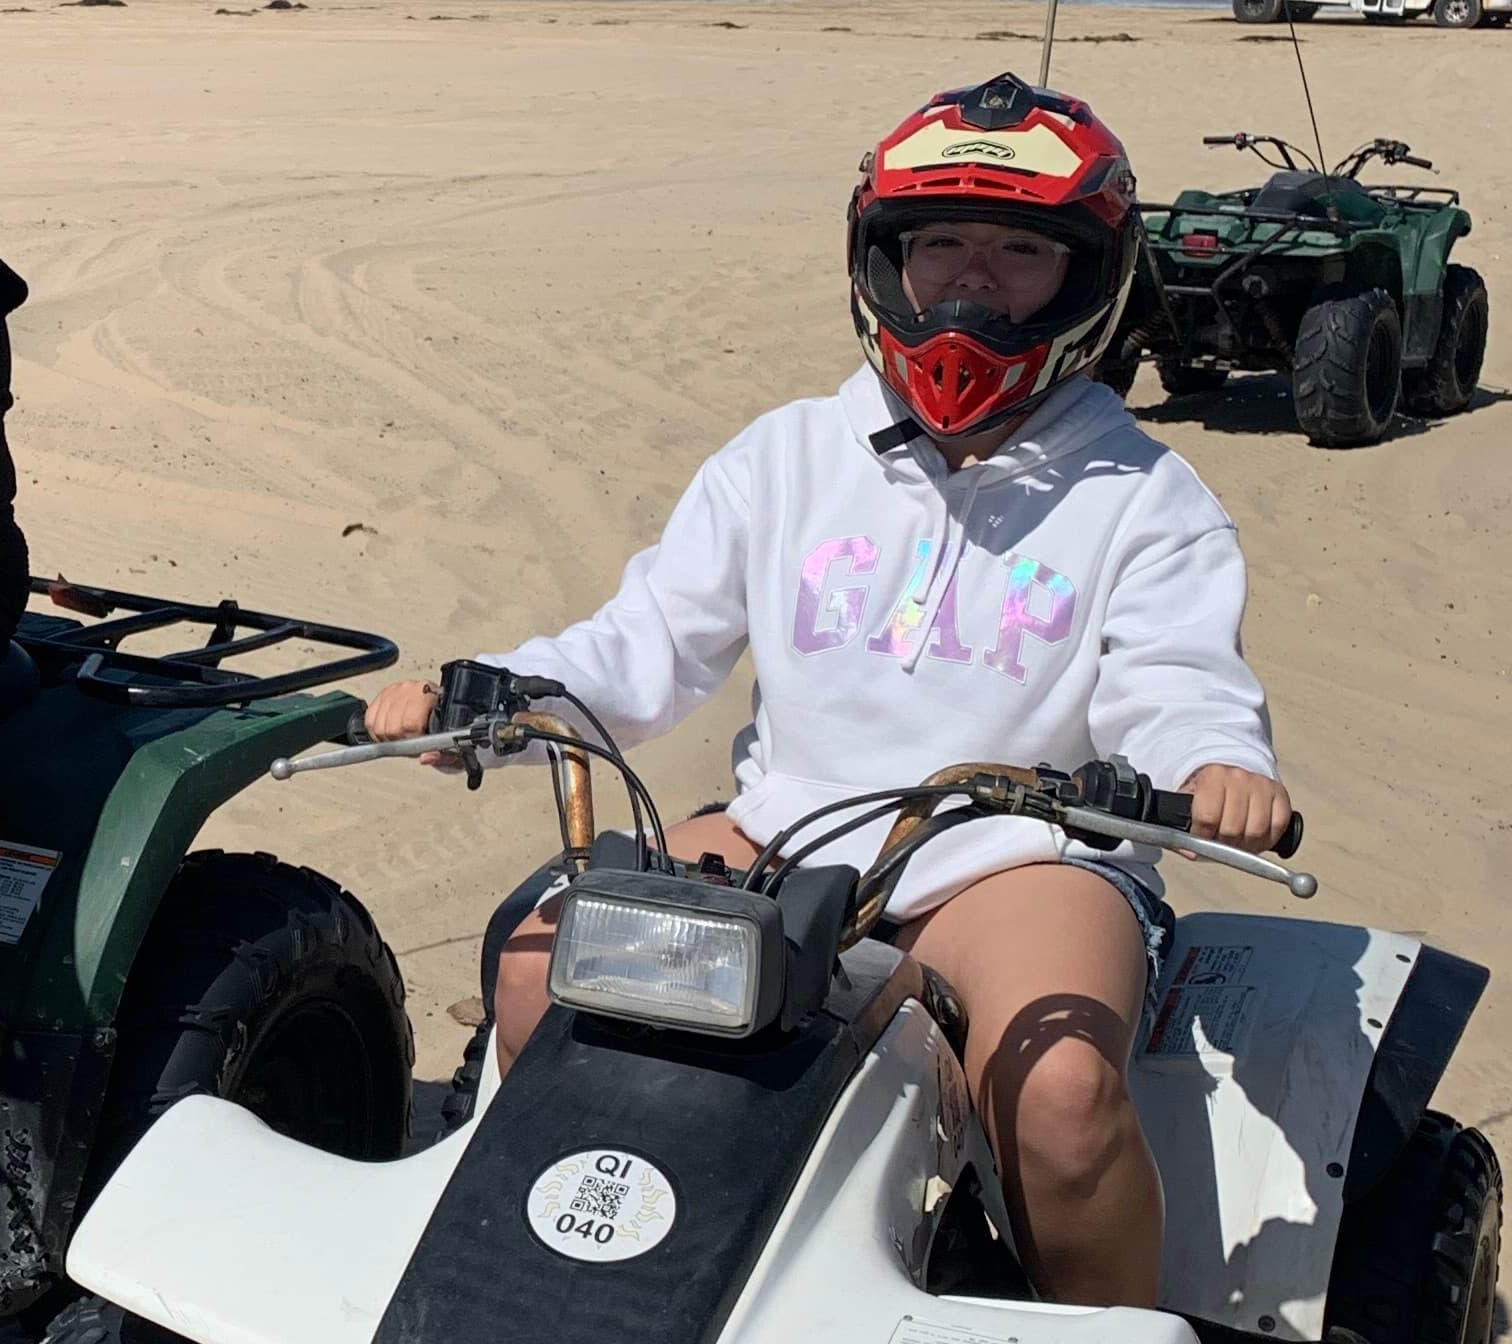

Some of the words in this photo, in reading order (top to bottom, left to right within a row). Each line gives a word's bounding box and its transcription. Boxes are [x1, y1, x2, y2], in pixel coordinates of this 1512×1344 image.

[791, 535, 1079, 686] GAP
[594, 1154, 633, 1180] QI
[555, 1213, 616, 1244] 040
